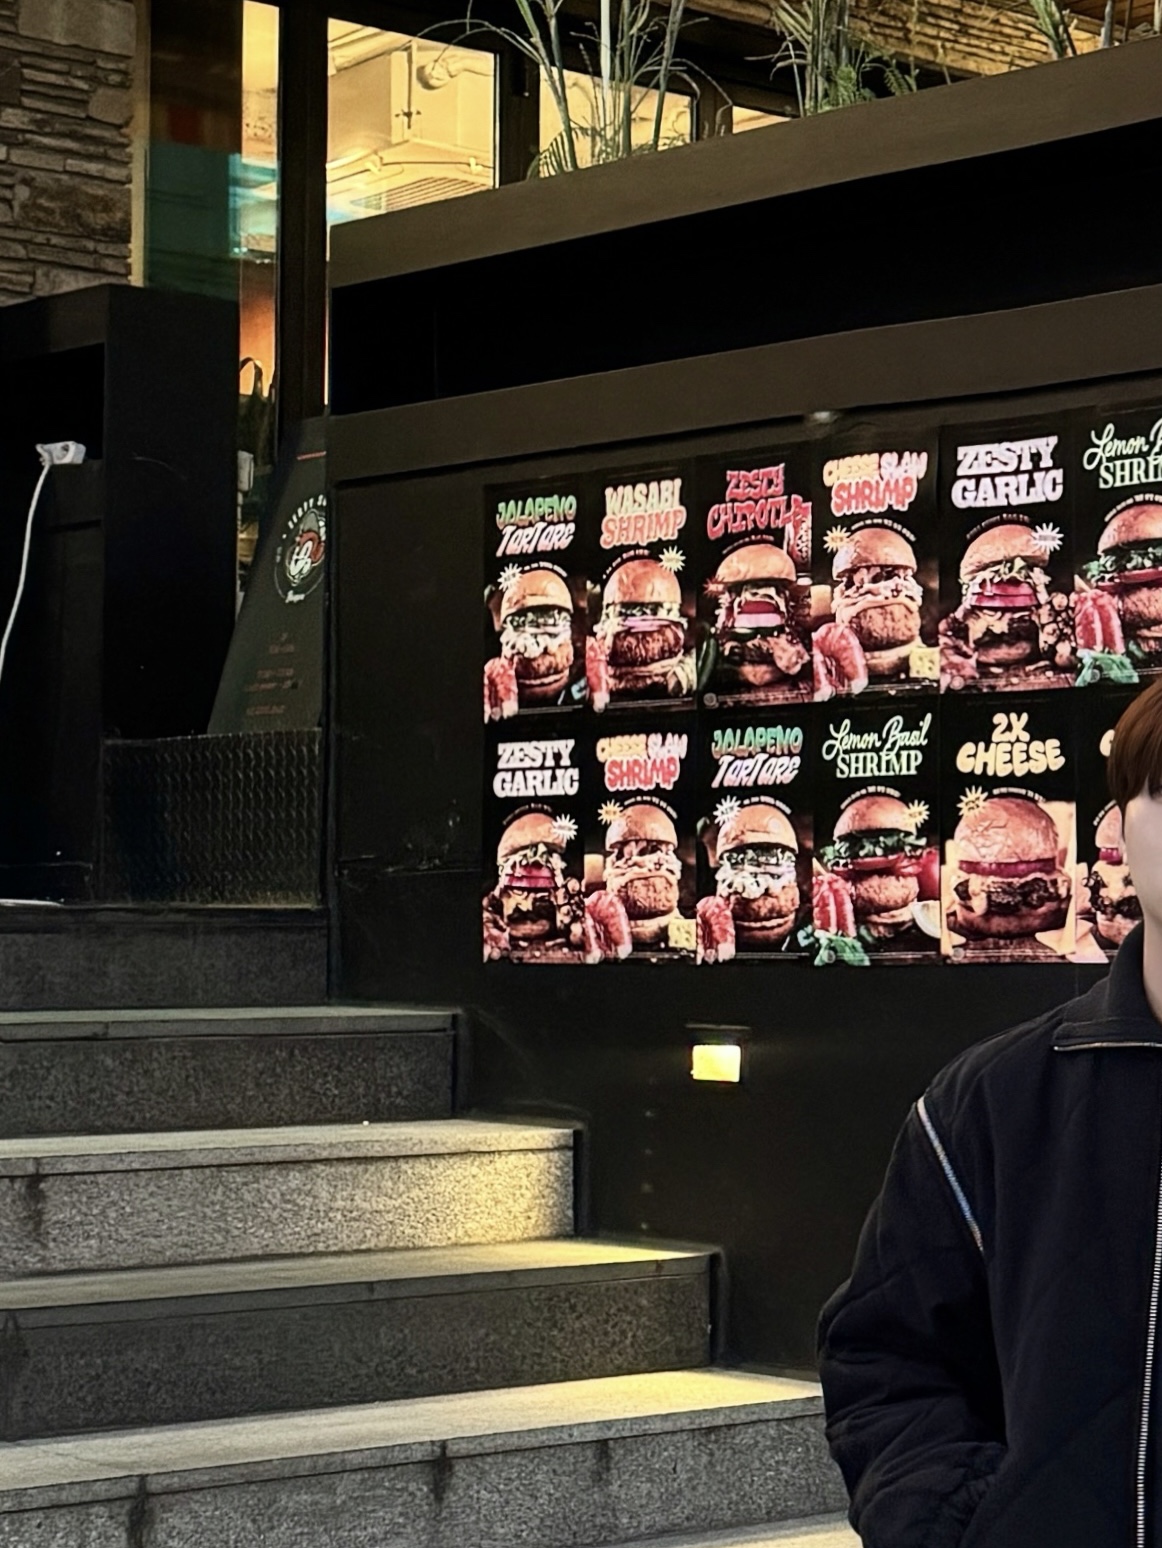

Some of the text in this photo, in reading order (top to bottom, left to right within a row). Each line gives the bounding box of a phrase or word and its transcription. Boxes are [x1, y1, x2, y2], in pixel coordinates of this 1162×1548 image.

[956, 436, 1058, 476] ZESTY
[1083, 423, 1149, 470] Lemon
[605, 478, 682, 516] WASABI
[725, 463, 785, 501] ZESTY
[831, 476, 918, 517] SHRIMP
[951, 468, 1063, 508] GARLIC
[600, 505, 686, 549] SHRIMP
[821, 713, 933, 760] Lemon Basil
[991, 712, 1030, 743] 2X
[497, 738, 575, 769] ZESTY
[836, 749, 923, 778] SHRIMP
[956, 738, 1066, 778] CHEESE
[493, 767, 579, 798] GARLIC
[604, 755, 680, 792] SHRIMP
